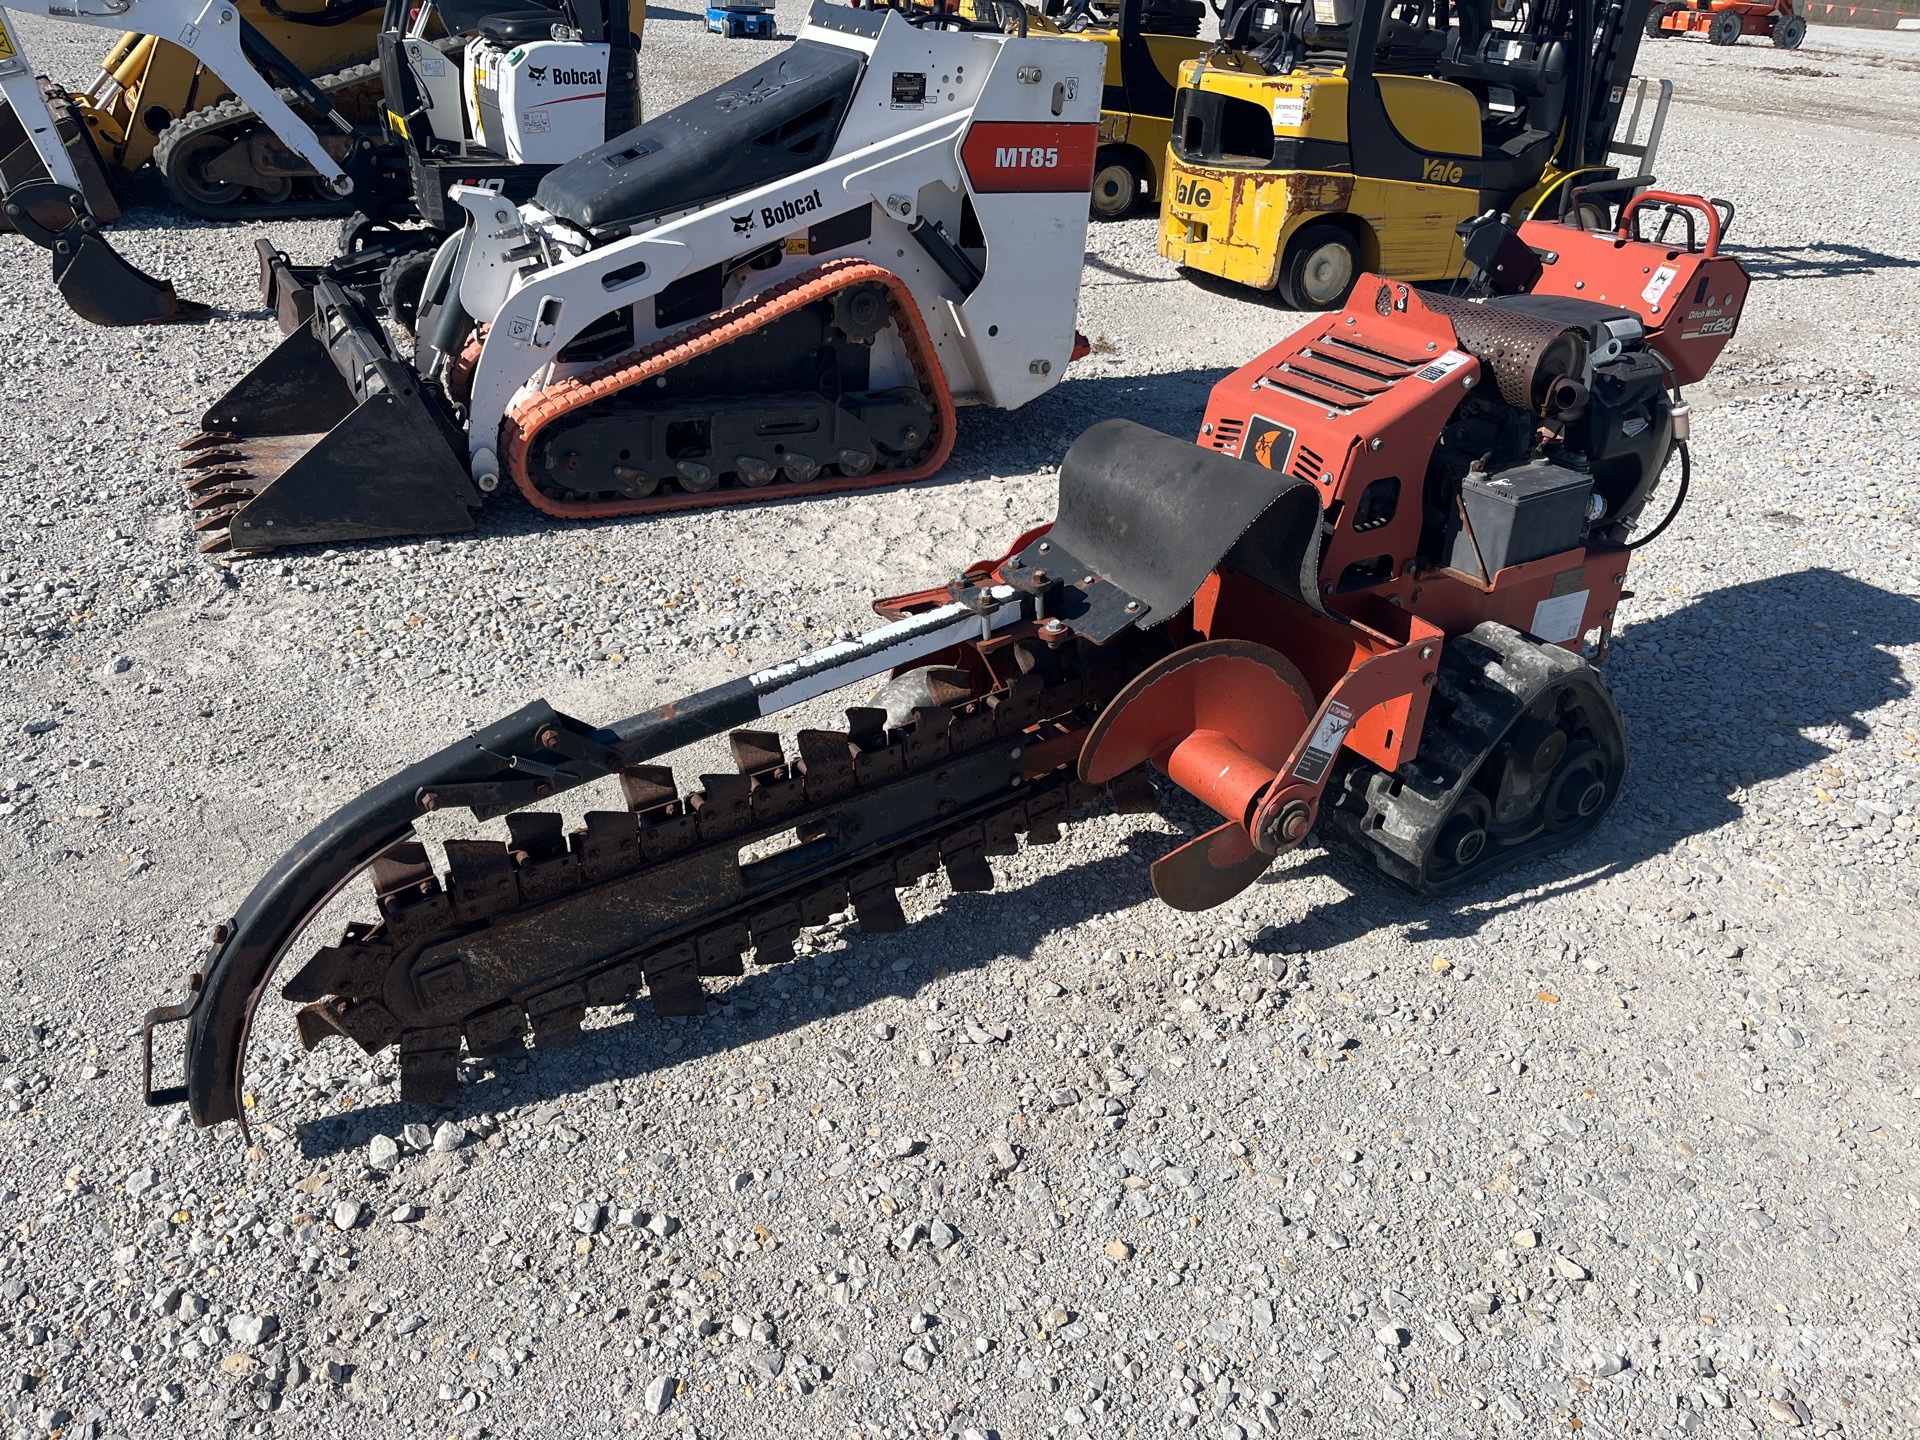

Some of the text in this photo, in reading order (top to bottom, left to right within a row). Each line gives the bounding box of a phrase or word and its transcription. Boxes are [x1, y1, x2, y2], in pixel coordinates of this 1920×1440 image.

[553, 68, 602, 85] Bobcat
[1275, 103, 1302, 111] U0996793
[995, 147, 1058, 168] MT85
[1422, 158, 1463, 184] Yale
[1175, 174, 1211, 208] Yale
[761, 189, 823, 229] Bobcat
[1688, 308, 1722, 319] Ditch Witch
[1701, 317, 1734, 332] RT24
